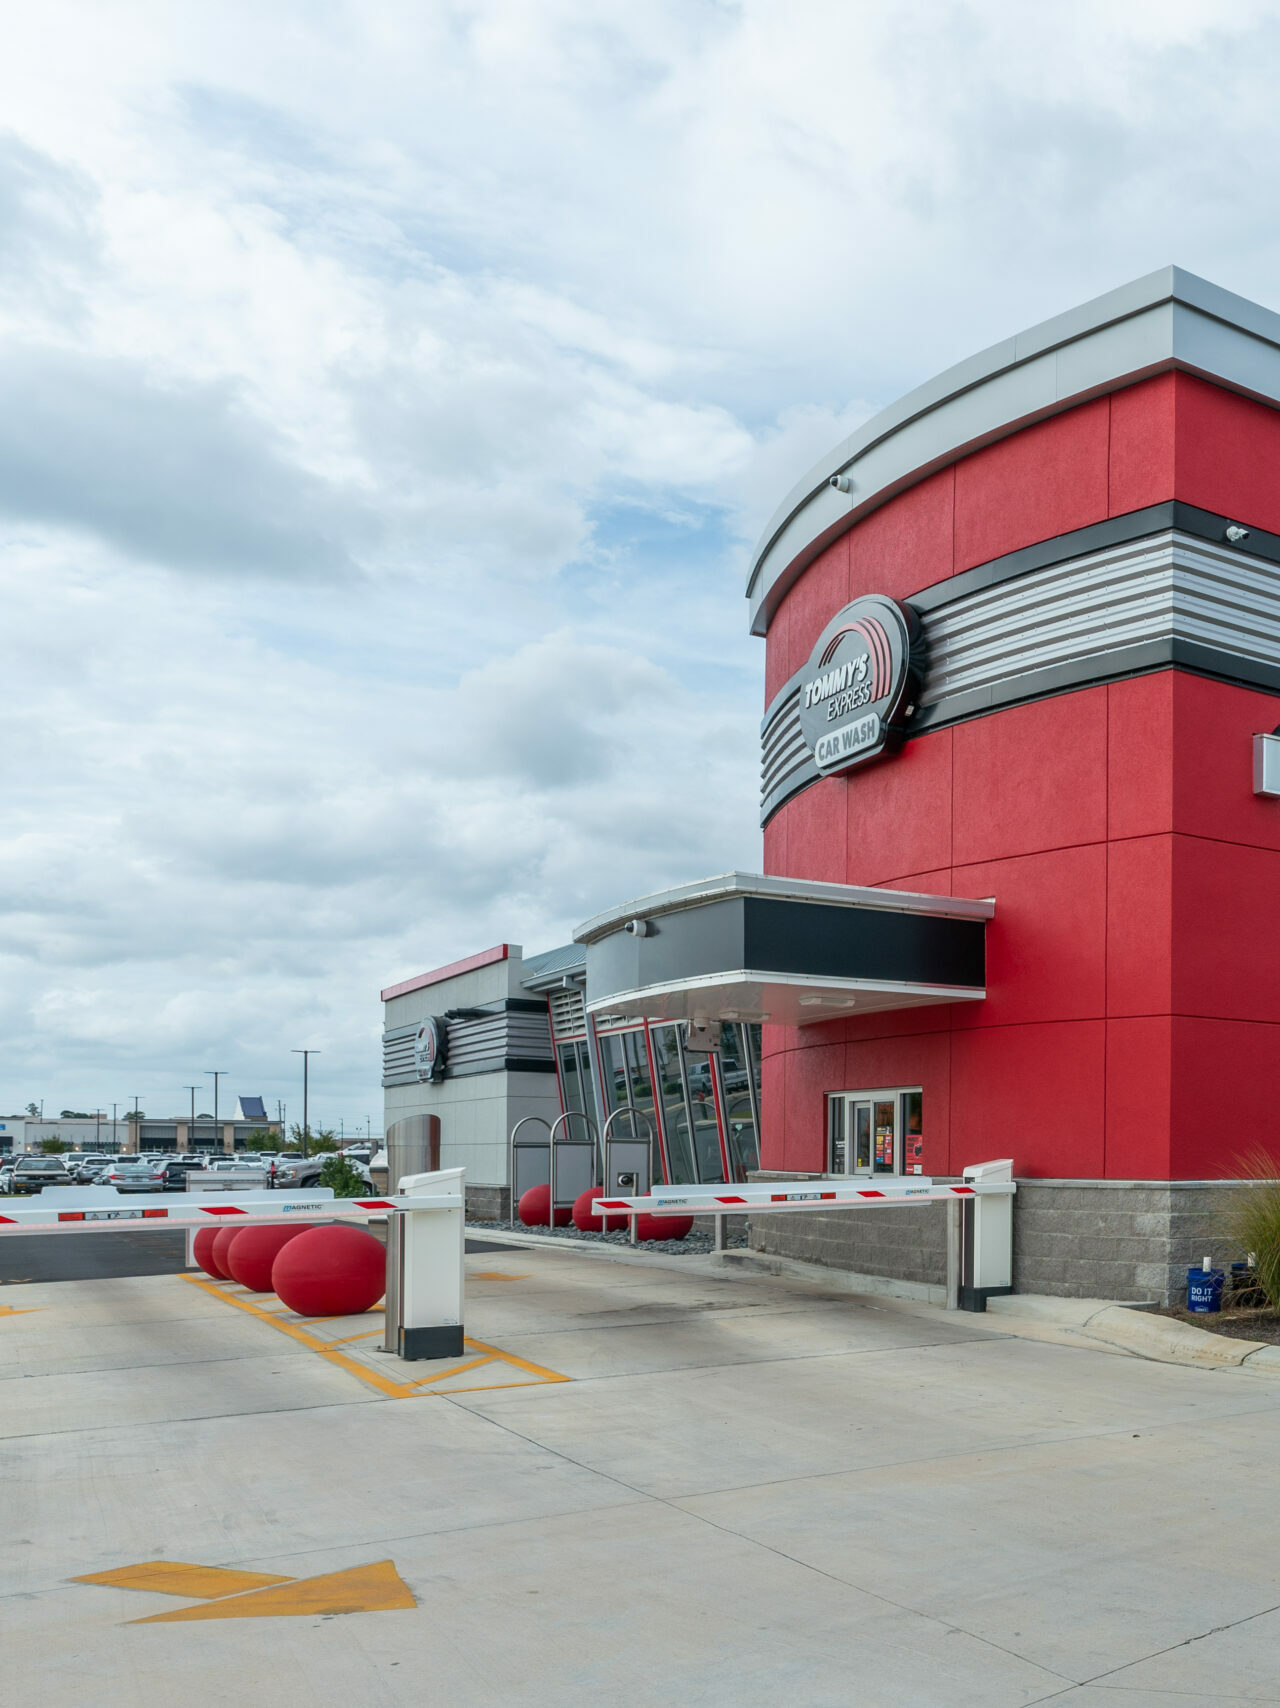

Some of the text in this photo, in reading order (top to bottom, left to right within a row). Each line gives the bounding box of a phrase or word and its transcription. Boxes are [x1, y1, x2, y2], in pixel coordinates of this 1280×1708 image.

[805, 653, 869, 709] TOMMY'S
[827, 681, 872, 721] EXPRESS
[818, 719, 875, 761] CAR WASH
[1191, 1287, 1213, 1295] DO IT
